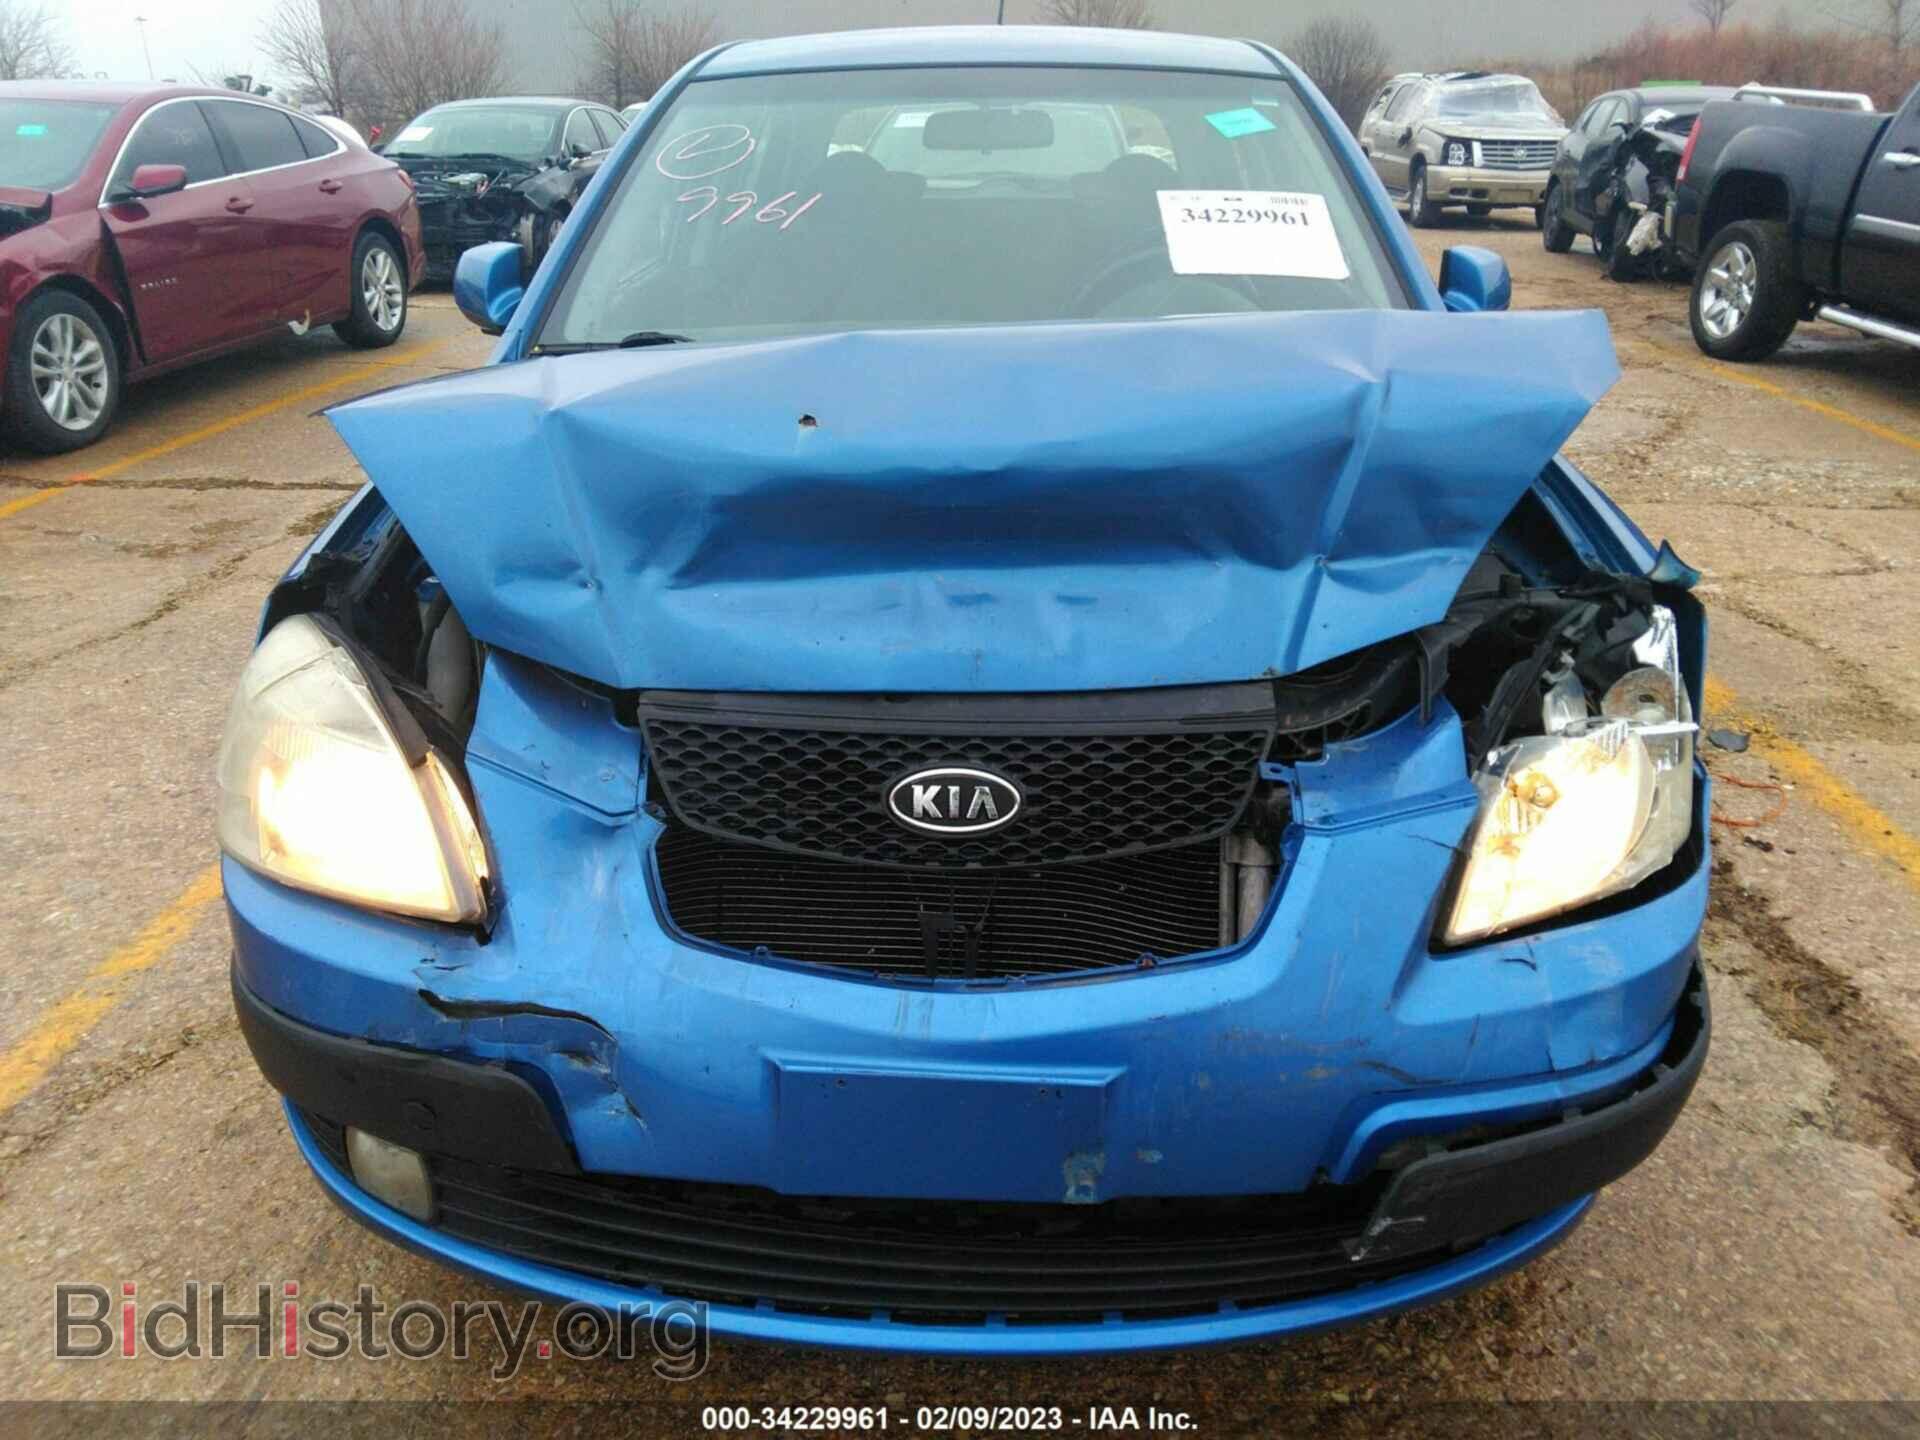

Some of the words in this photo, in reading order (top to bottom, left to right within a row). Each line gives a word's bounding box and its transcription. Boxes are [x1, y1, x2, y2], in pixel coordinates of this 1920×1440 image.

[677, 185, 823, 229] 9961
[1181, 207, 1309, 226] 34229961
[911, 784, 999, 820] KIA
